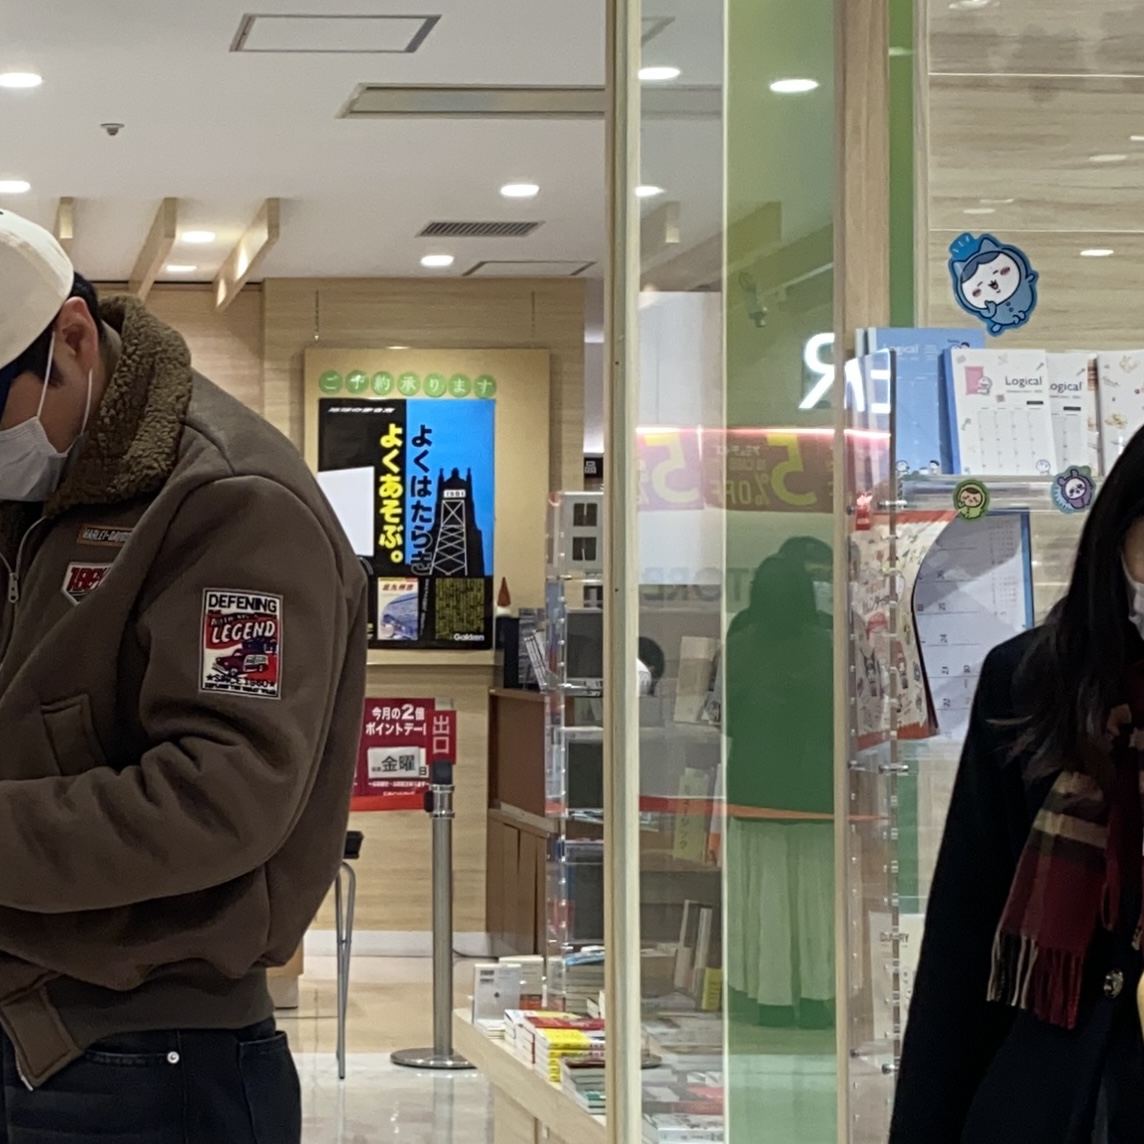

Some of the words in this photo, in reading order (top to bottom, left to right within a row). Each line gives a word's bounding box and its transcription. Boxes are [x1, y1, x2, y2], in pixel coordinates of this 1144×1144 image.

[323, 371, 494, 394] ご予約承ります
[1005, 375, 1043, 388] Logical
[1049, 381, 1083, 393] ogical
[378, 423, 404, 564] よくあそぶ。
[410, 424, 434, 576] よくはたらき
[210, 620, 276, 644] LEGEND
[372, 703, 425, 721] 今月の2倍
[365, 722, 427, 736] ポイントデー
[432, 715, 450, 754] 出口
[381, 755, 416, 772] 金曜
